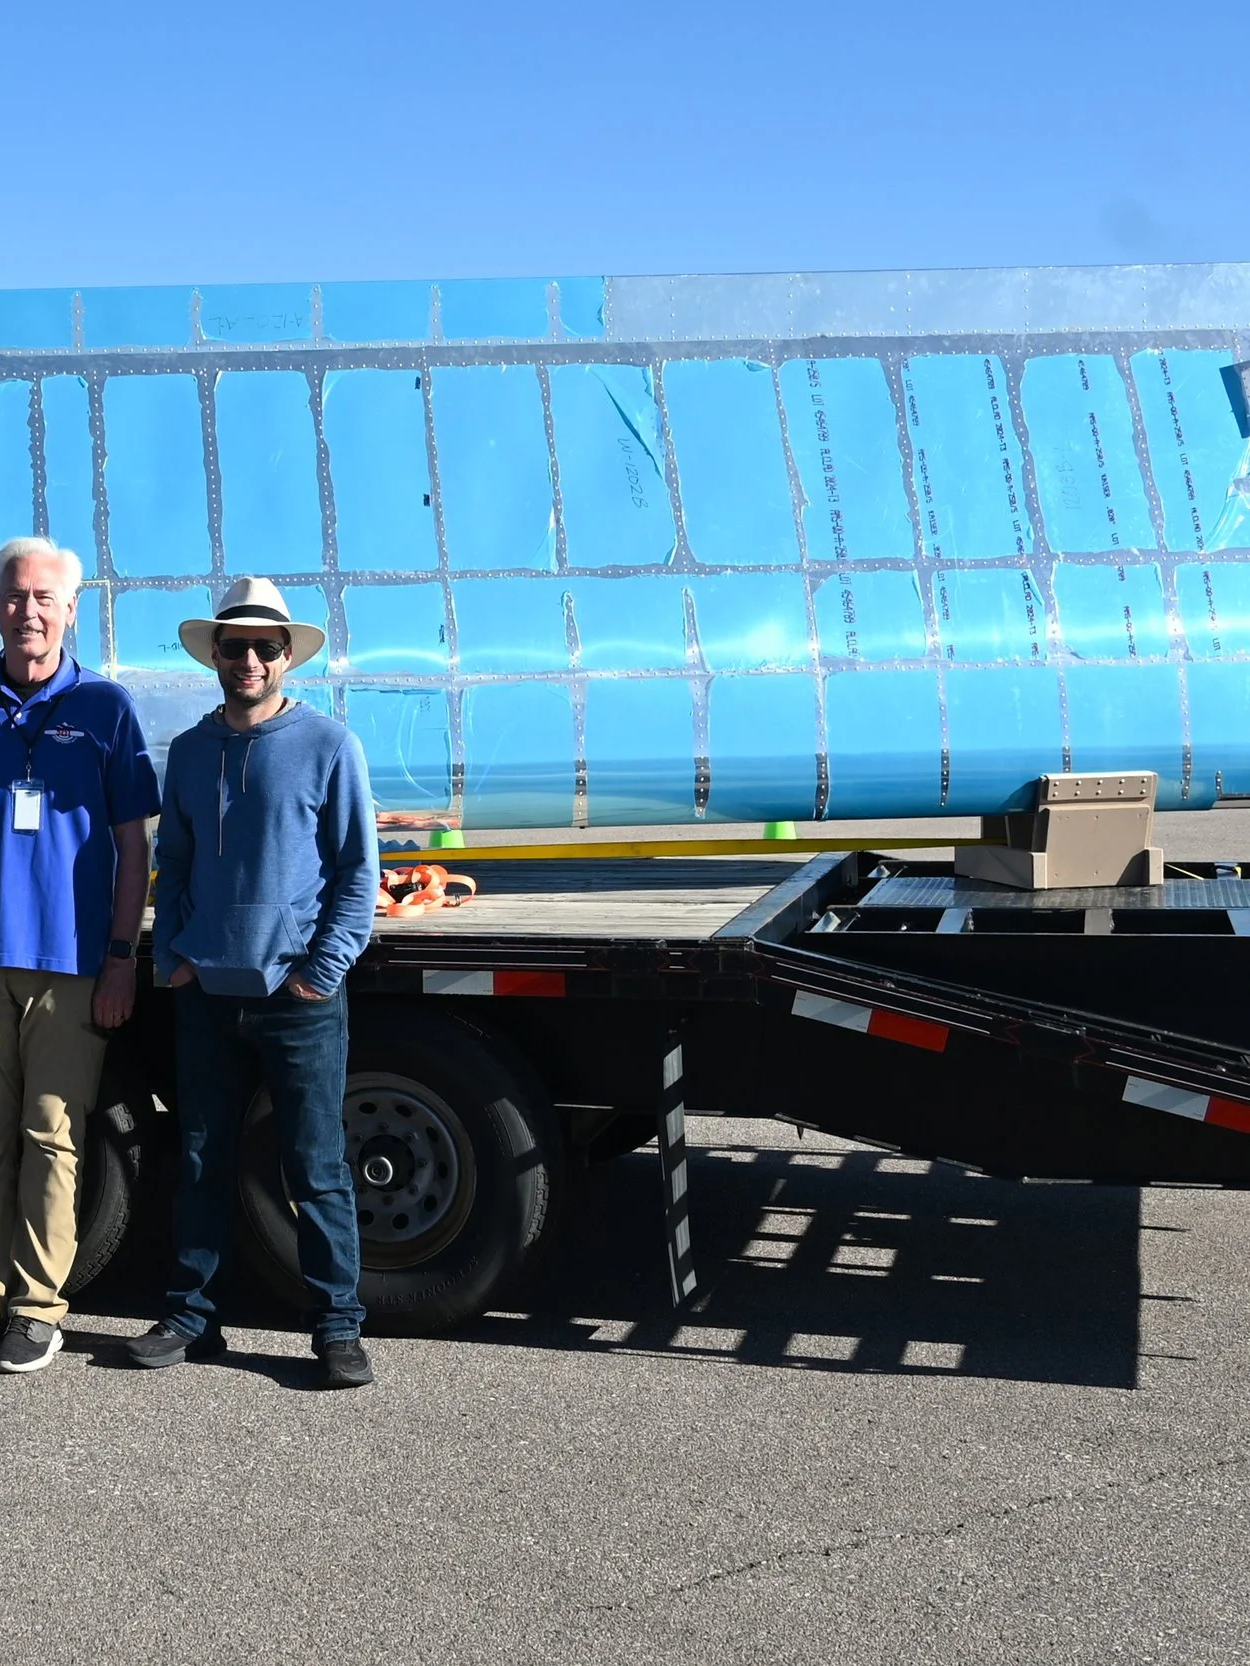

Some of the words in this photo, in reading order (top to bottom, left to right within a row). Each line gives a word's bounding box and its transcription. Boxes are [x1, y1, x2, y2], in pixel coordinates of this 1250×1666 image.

[812, 394, 825, 407] LOT
[819, 447, 835, 473] ALCLAD
[990, 396, 1002, 420] ALCLAD
[905, 379, 914, 391] LOT
[927, 510, 939, 536] KAISER
[995, 423, 1008, 452] 2024-T3
[1159, 358, 1171, 386] 2024-T3
[1166, 392, 1185, 447] AMS-QQ-A-250/5
[1180, 453, 1189, 466] LOT
[1190, 507, 1202, 533] ALCLAD
[1001, 458, 1018, 514] AMS-QQ-A-250/5
[1088, 412, 1105, 468] AMS-QQ-A-250/5
[1100, 473, 1111, 498] KAISER
[1111, 533, 1120, 545] LOT
[1012, 519, 1023, 532] LOT
[1212, 638, 1222, 652] LOT
